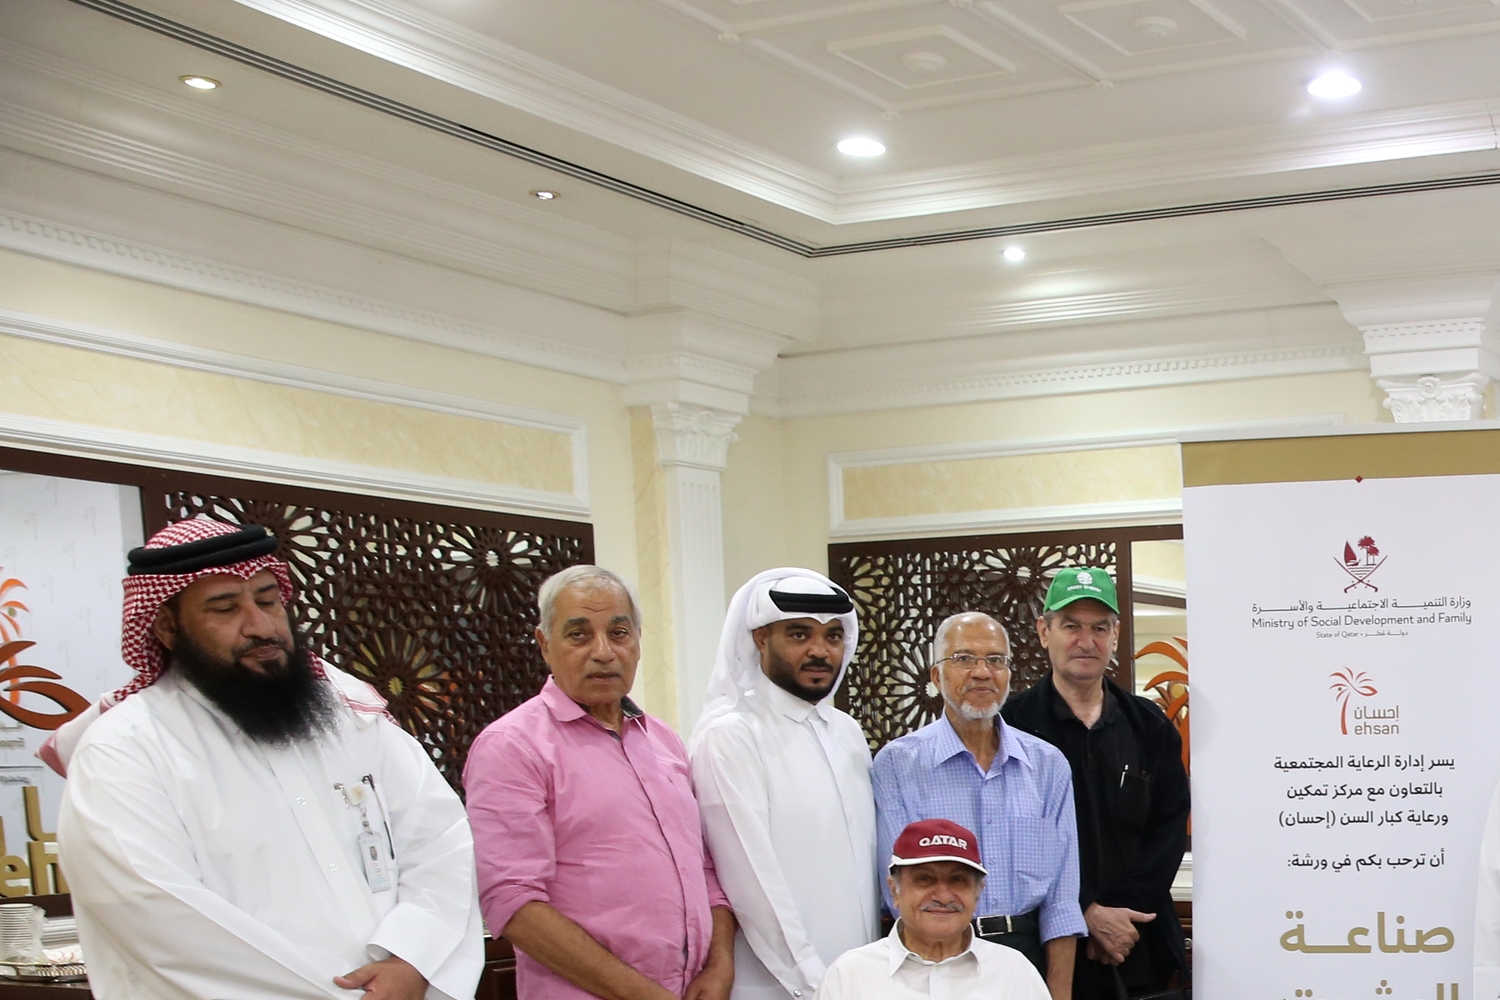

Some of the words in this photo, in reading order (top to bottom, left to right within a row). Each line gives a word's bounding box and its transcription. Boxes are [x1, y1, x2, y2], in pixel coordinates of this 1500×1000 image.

[1252, 599, 1314, 614] والأسرة
[1316, 598, 1389, 612] الاجتماعية
[1391, 596, 1448, 610] التنمية
[1449, 596, 1472, 609] وزارة
[1252, 617, 1294, 630] Ministry
[1297, 616, 1308, 627] of
[1311, 615, 1341, 627] Social
[1344, 614, 1414, 627] Development
[1416, 613, 1435, 624] and
[1438, 612, 1472, 625] Family
[1316, 631, 1333, 639] State
[1333, 630, 1341, 638] of
[1354, 704, 1399, 722] إحسان
[1354, 721, 1399, 735] ehsan
[1273, 755, 1344, 773] المجتمعية
[1347, 755, 1391, 771] الرعاية
[1394, 754, 1425, 772] إدارة
[1428, 756, 1455, 772] يسر
[1286, 782, 1329, 799] تمكين
[1332, 782, 1363, 799] مركز
[1366, 785, 1386, 802] مع
[1388, 782, 1444, 798] بالتعاون
[1278, 811, 1336, 829] (إحسان)
[1340, 811, 1375, 826] السن
[1377, 810, 1403, 826] كبار
[1406, 810, 1449, 826] ورعاية
[918, 834, 968, 850] QATAR
[1287, 854, 1328, 871] ورشة:
[1331, 855, 1352, 872] في
[1355, 852, 1383, 872] بكم
[1386, 853, 1426, 869] ترحب
[1429, 847, 1446, 867] أن
[1279, 910, 1455, 954] صناعة
